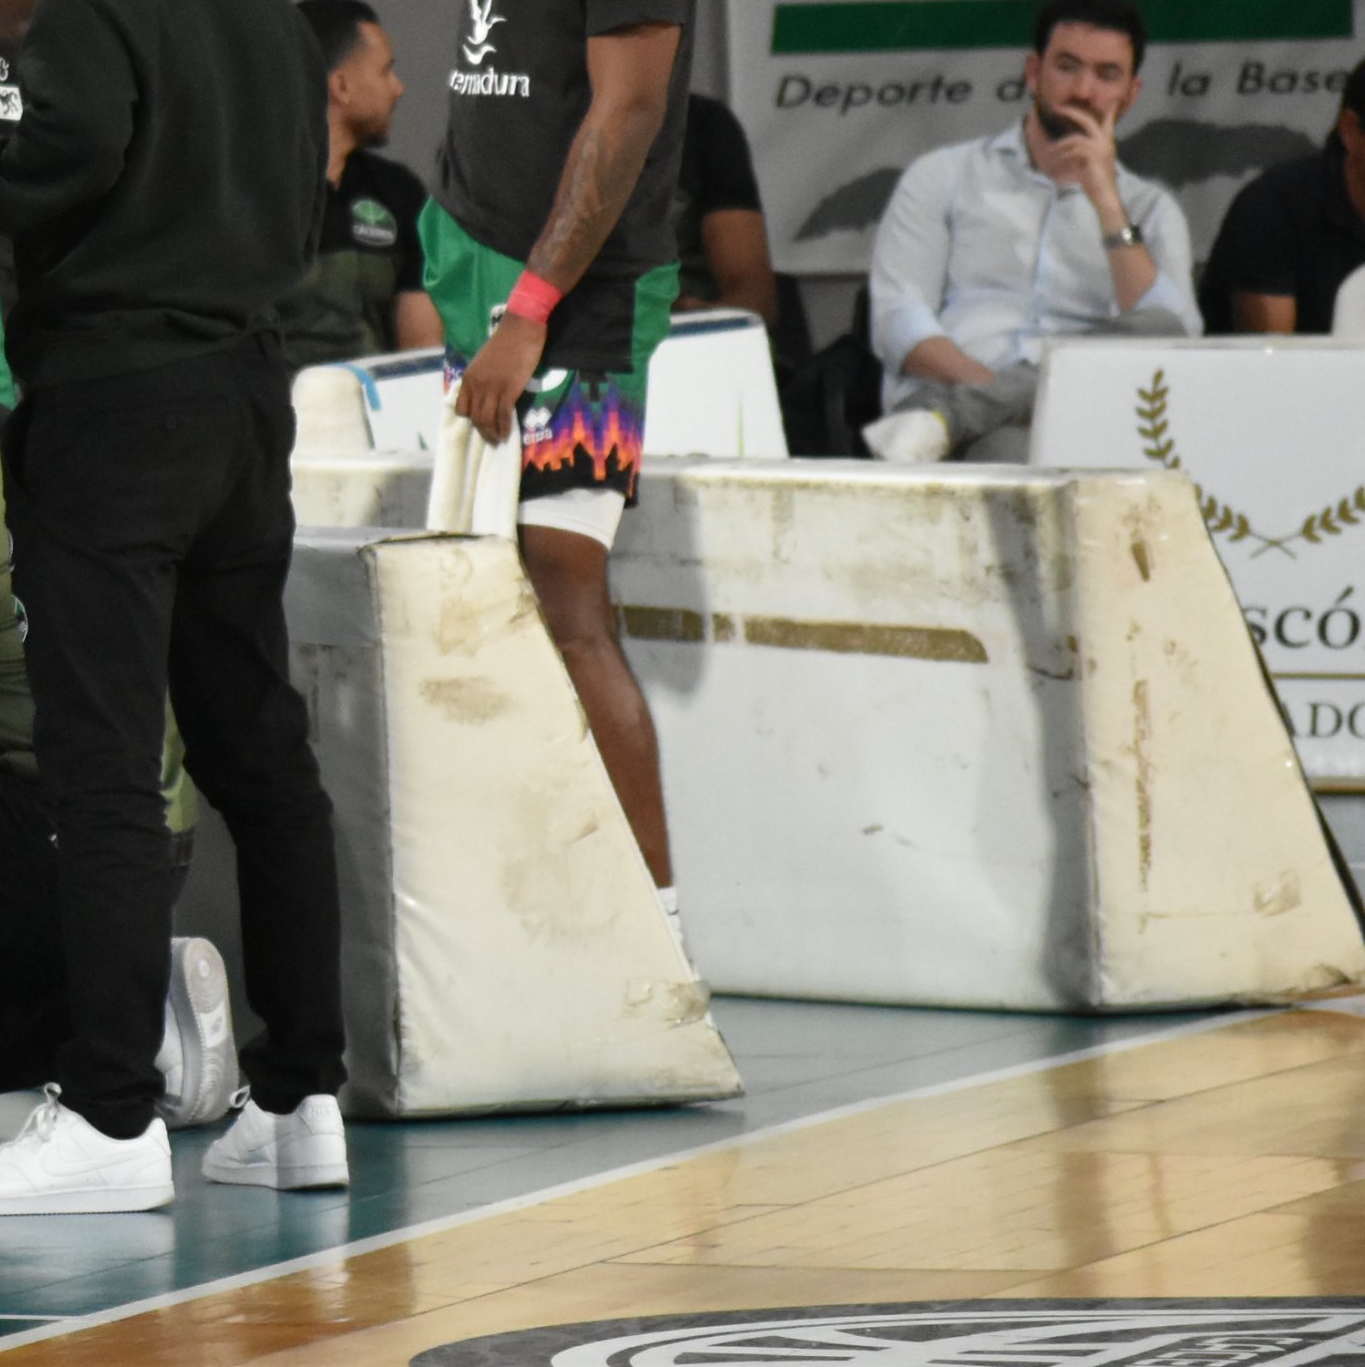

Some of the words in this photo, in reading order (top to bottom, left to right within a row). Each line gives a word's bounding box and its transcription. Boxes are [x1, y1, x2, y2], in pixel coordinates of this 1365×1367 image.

[775, 72, 974, 116] Deporte
[1166, 64, 1211, 98] la
[1236, 61, 1351, 97] Base
